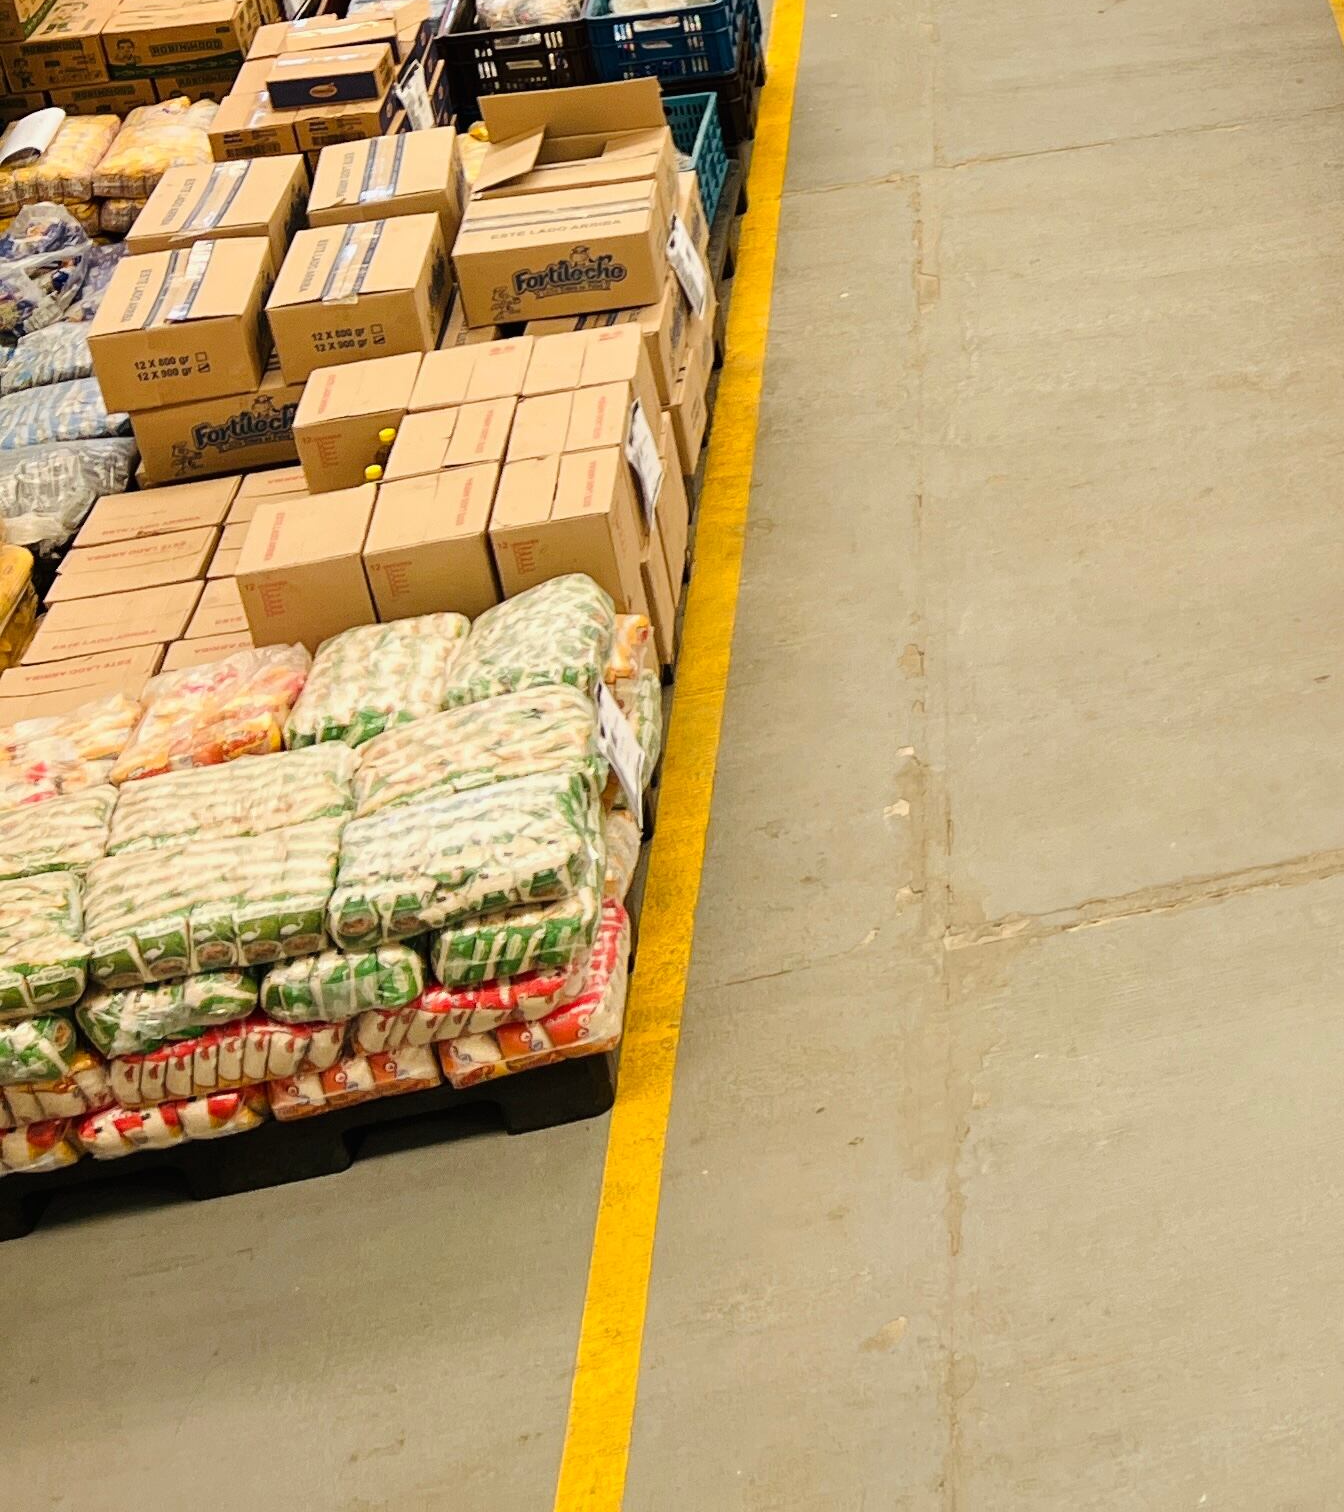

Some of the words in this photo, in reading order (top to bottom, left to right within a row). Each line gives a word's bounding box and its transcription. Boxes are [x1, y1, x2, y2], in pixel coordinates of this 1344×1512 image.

[491, 231, 526, 240] ESTE
[530, 225, 568, 235] LADO
[512, 254, 627, 295] Fortileche
[311, 332, 323, 341] 12
[314, 343, 326, 352] 12
[134, 360, 146, 370] 12
[148, 359, 156, 368] X
[137, 371, 149, 382] 12
[151, 370, 159, 380] X
[192, 403, 299, 449] Fortilech
